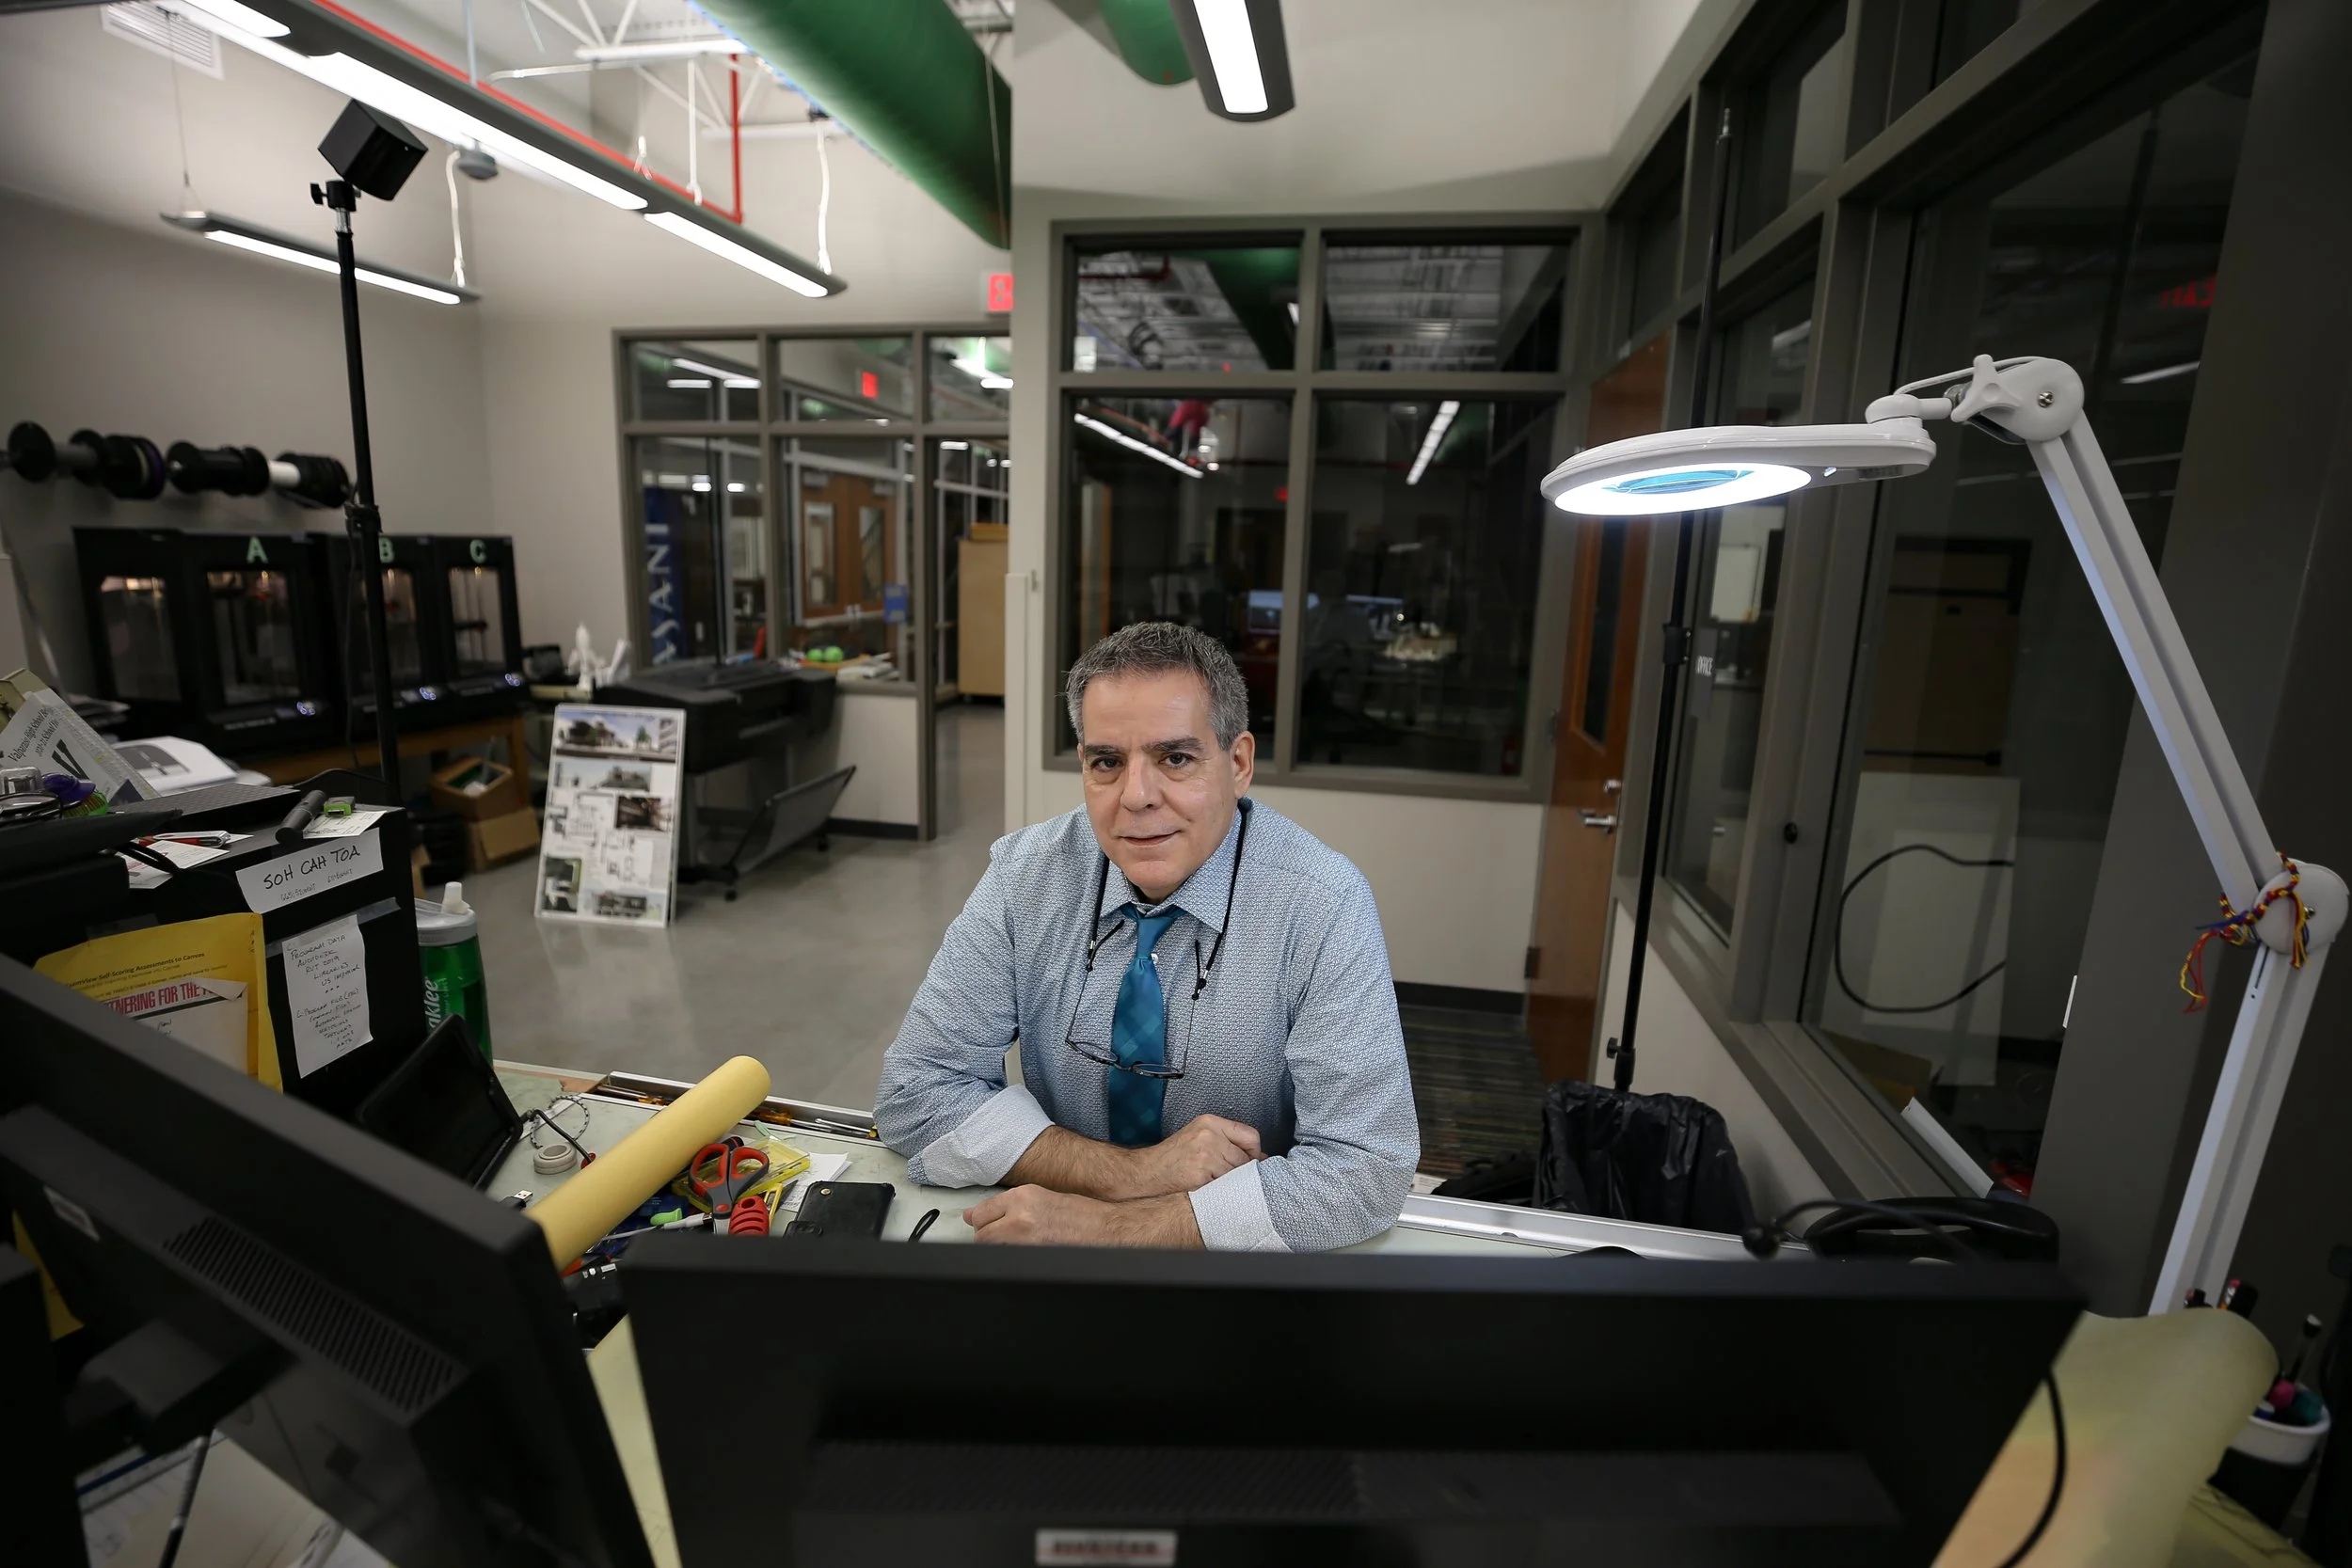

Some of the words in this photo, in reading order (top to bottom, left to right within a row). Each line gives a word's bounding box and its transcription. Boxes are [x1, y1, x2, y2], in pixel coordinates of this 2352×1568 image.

[246, 536, 268, 563] A
[378, 538, 394, 562] B
[469, 539, 486, 563] C
[1696, 655, 1713, 676] OFFICE
[8, 736, 30, 763] Valparaiso
[263, 864, 294, 890] SOH
[300, 855, 326, 876] CAH
[330, 845, 360, 863] TOA
[327, 935, 346, 945] DATA
[135, 958, 175, 973] Assessments
[183, 951, 205, 961] Canvas
[103, 994, 156, 1017] TNERING
[158, 989, 179, 1006] FOR
[181, 983, 201, 1001] THE
